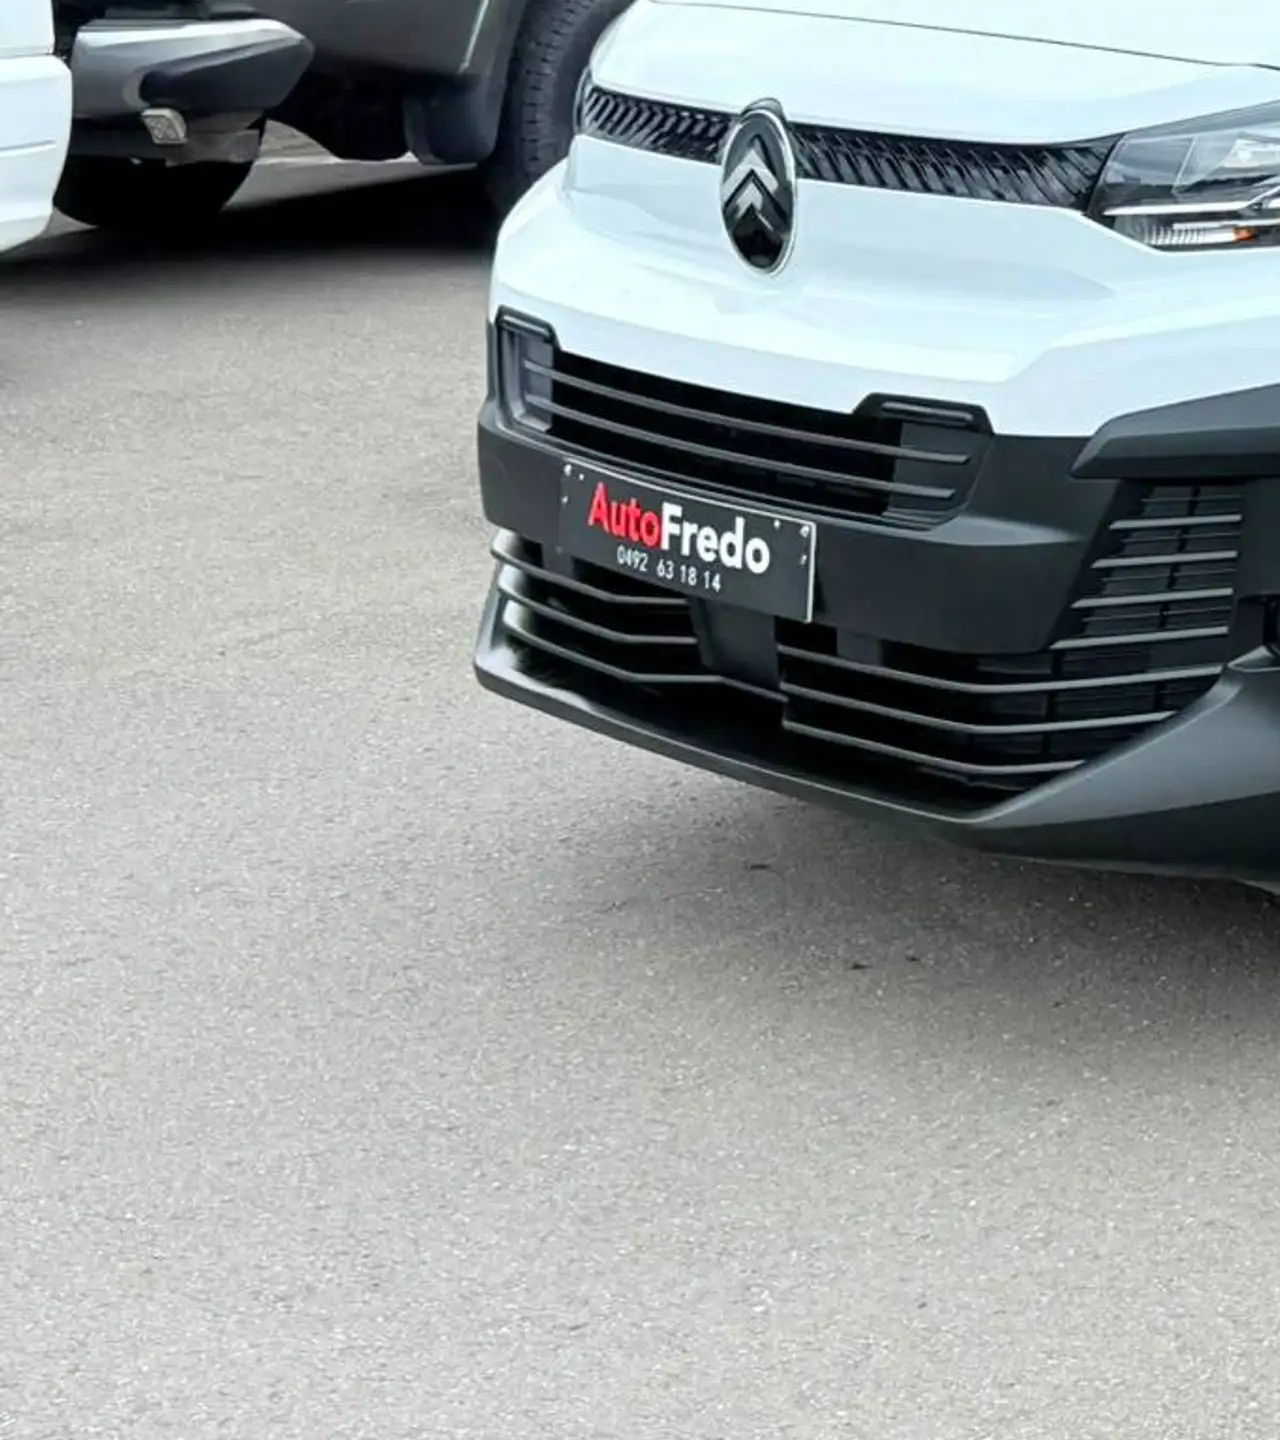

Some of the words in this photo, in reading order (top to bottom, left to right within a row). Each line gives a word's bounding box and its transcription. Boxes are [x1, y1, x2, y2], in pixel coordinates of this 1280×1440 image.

[587, 481, 771, 575] AutoFredo
[616, 544, 649, 573] 0492
[656, 558, 675, 581] 63
[679, 564, 697, 587] 18
[702, 570, 722, 594] 14
